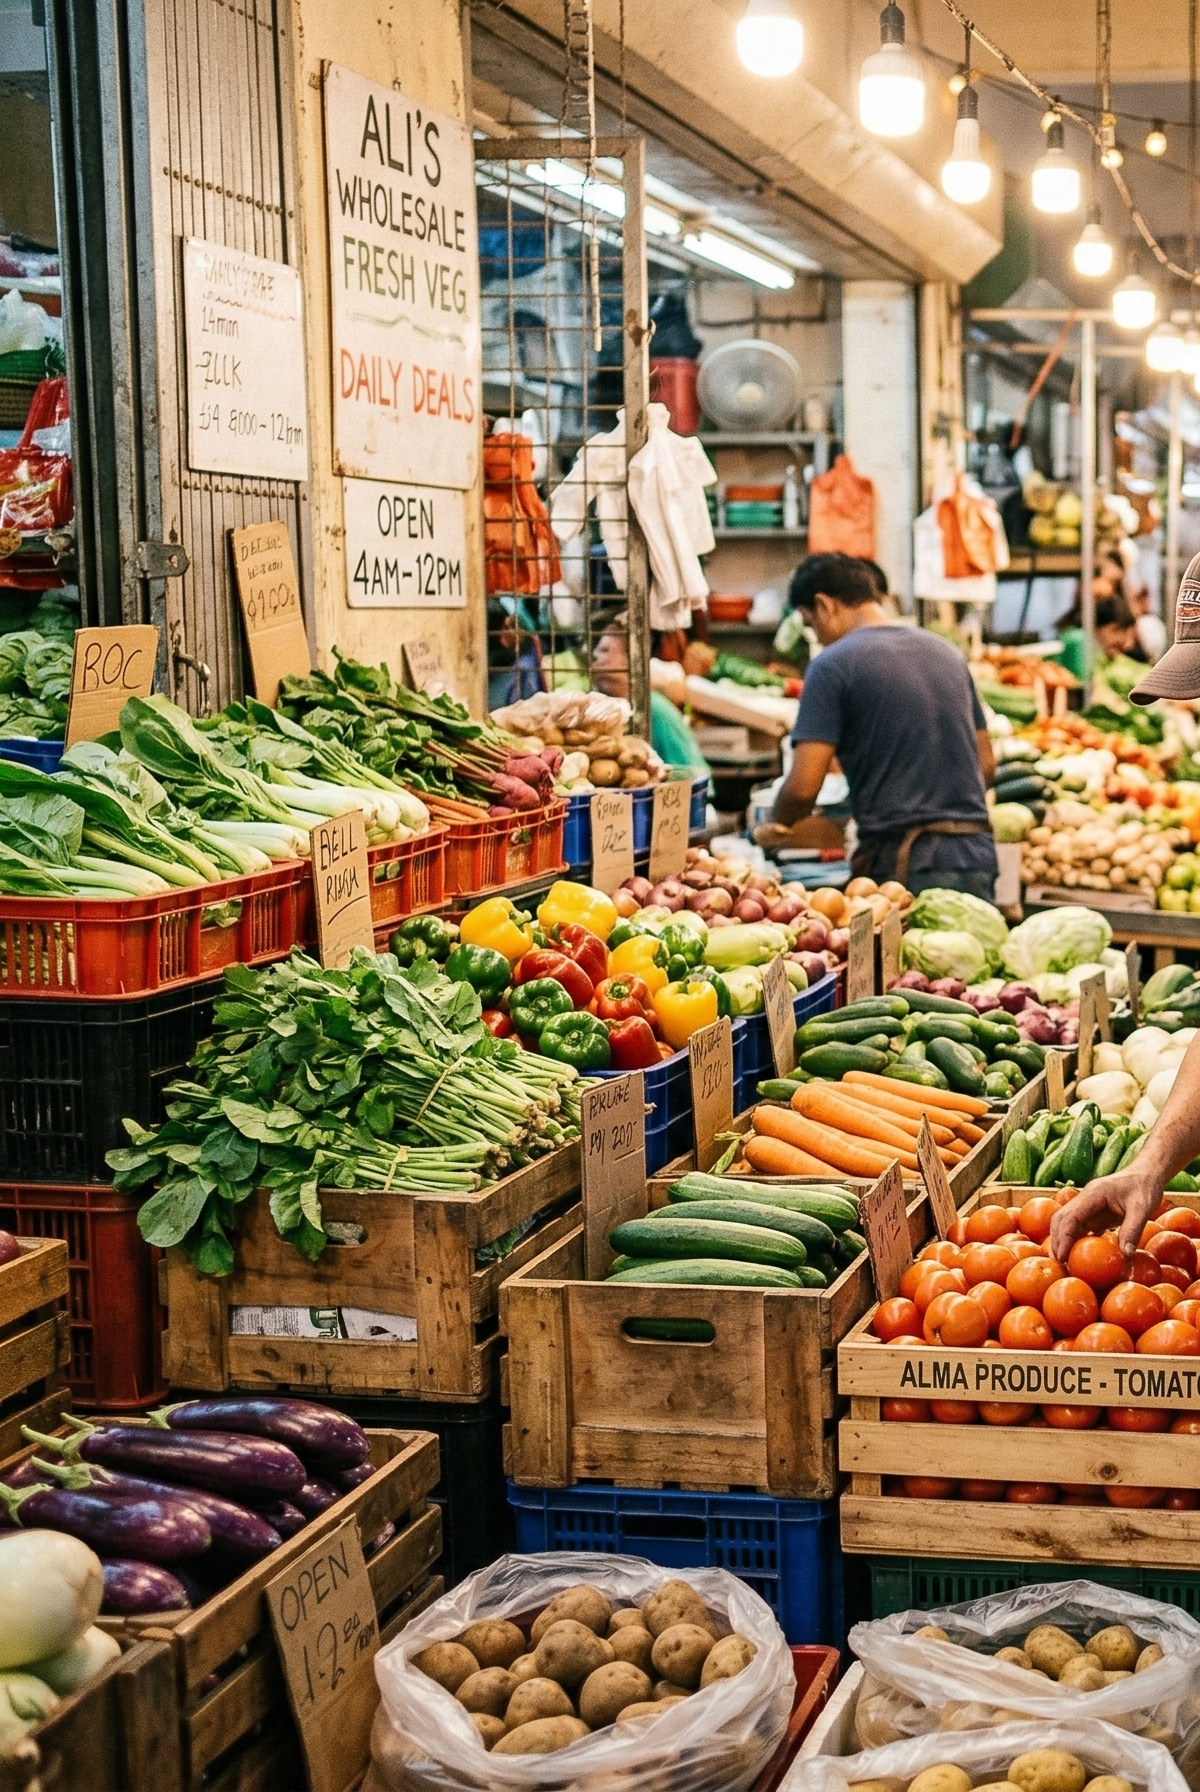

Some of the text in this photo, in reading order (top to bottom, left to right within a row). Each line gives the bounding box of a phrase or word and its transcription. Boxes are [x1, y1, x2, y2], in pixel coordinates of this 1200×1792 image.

[360, 94, 441, 187] ALI'S
[336, 168, 466, 252] WHOLESALE
[343, 235, 415, 304] FRESH
[424, 260, 467, 314] VEG
[340, 349, 475, 424] DAILY DEALS
[377, 495, 434, 539] OPEN
[353, 550, 462, 596] 4AM-12PM
[83, 642, 142, 692] ROC
[900, 1360, 969, 1390] ALMA
[975, 1363, 1092, 1395] PRODUCE
[280, 1541, 350, 1631] OPEN
